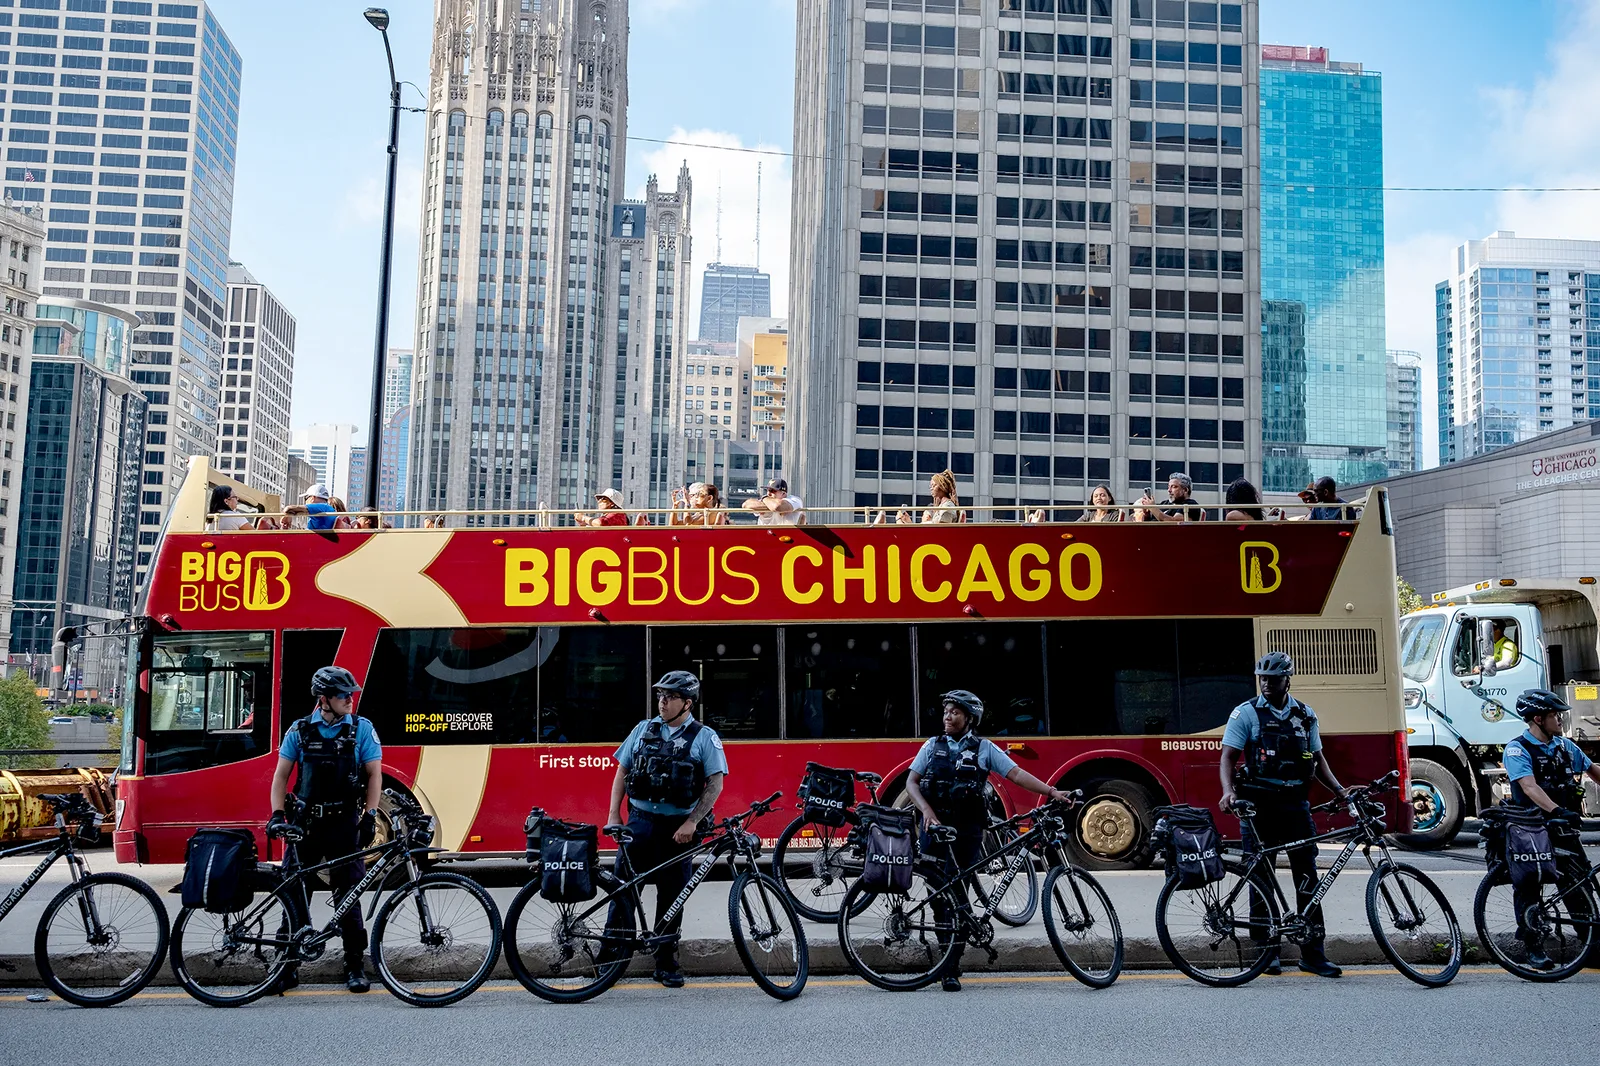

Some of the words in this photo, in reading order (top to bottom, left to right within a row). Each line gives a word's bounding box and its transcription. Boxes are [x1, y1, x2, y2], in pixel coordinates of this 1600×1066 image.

[1556, 450, 1587, 461] UNIVERSITY
[1544, 455, 1597, 475] CHICAGO
[1516, 480, 1533, 491] THE
[1533, 474, 1578, 488] GLEACHER
[180, 551, 242, 582] BIG
[781, 542, 1104, 605] CHICAGO
[179, 584, 241, 611] BUS
[1477, 687, 1508, 696] S11770
[405, 713, 444, 723] HOP-ON
[445, 713, 493, 722] DISCOVER
[405, 723, 449, 733] HOP-OFF
[450, 721, 493, 731] EXPLORE
[539, 755, 575, 769] First
[578, 755, 615, 771] stop.
[808, 795, 843, 809] POLICE
[872, 854, 909, 865] POLICE
[1181, 849, 1215, 862] POLICE
[1513, 852, 1552, 862] POLICE
[544, 861, 584, 870] POLICE
[356, 864, 380, 892] POLICE
[1311, 874, 1335, 905] CHICAGO
[1331, 847, 1352, 875] POLICE
[0, 886, 25, 917] HICAGO
[23, 859, 50, 886] POLICE
[663, 887, 691, 922] CHICAGO
[688, 860, 711, 889] POLICE
[985, 882, 1008, 916] CHICAGO
[1003, 855, 1024, 882] POLICE
